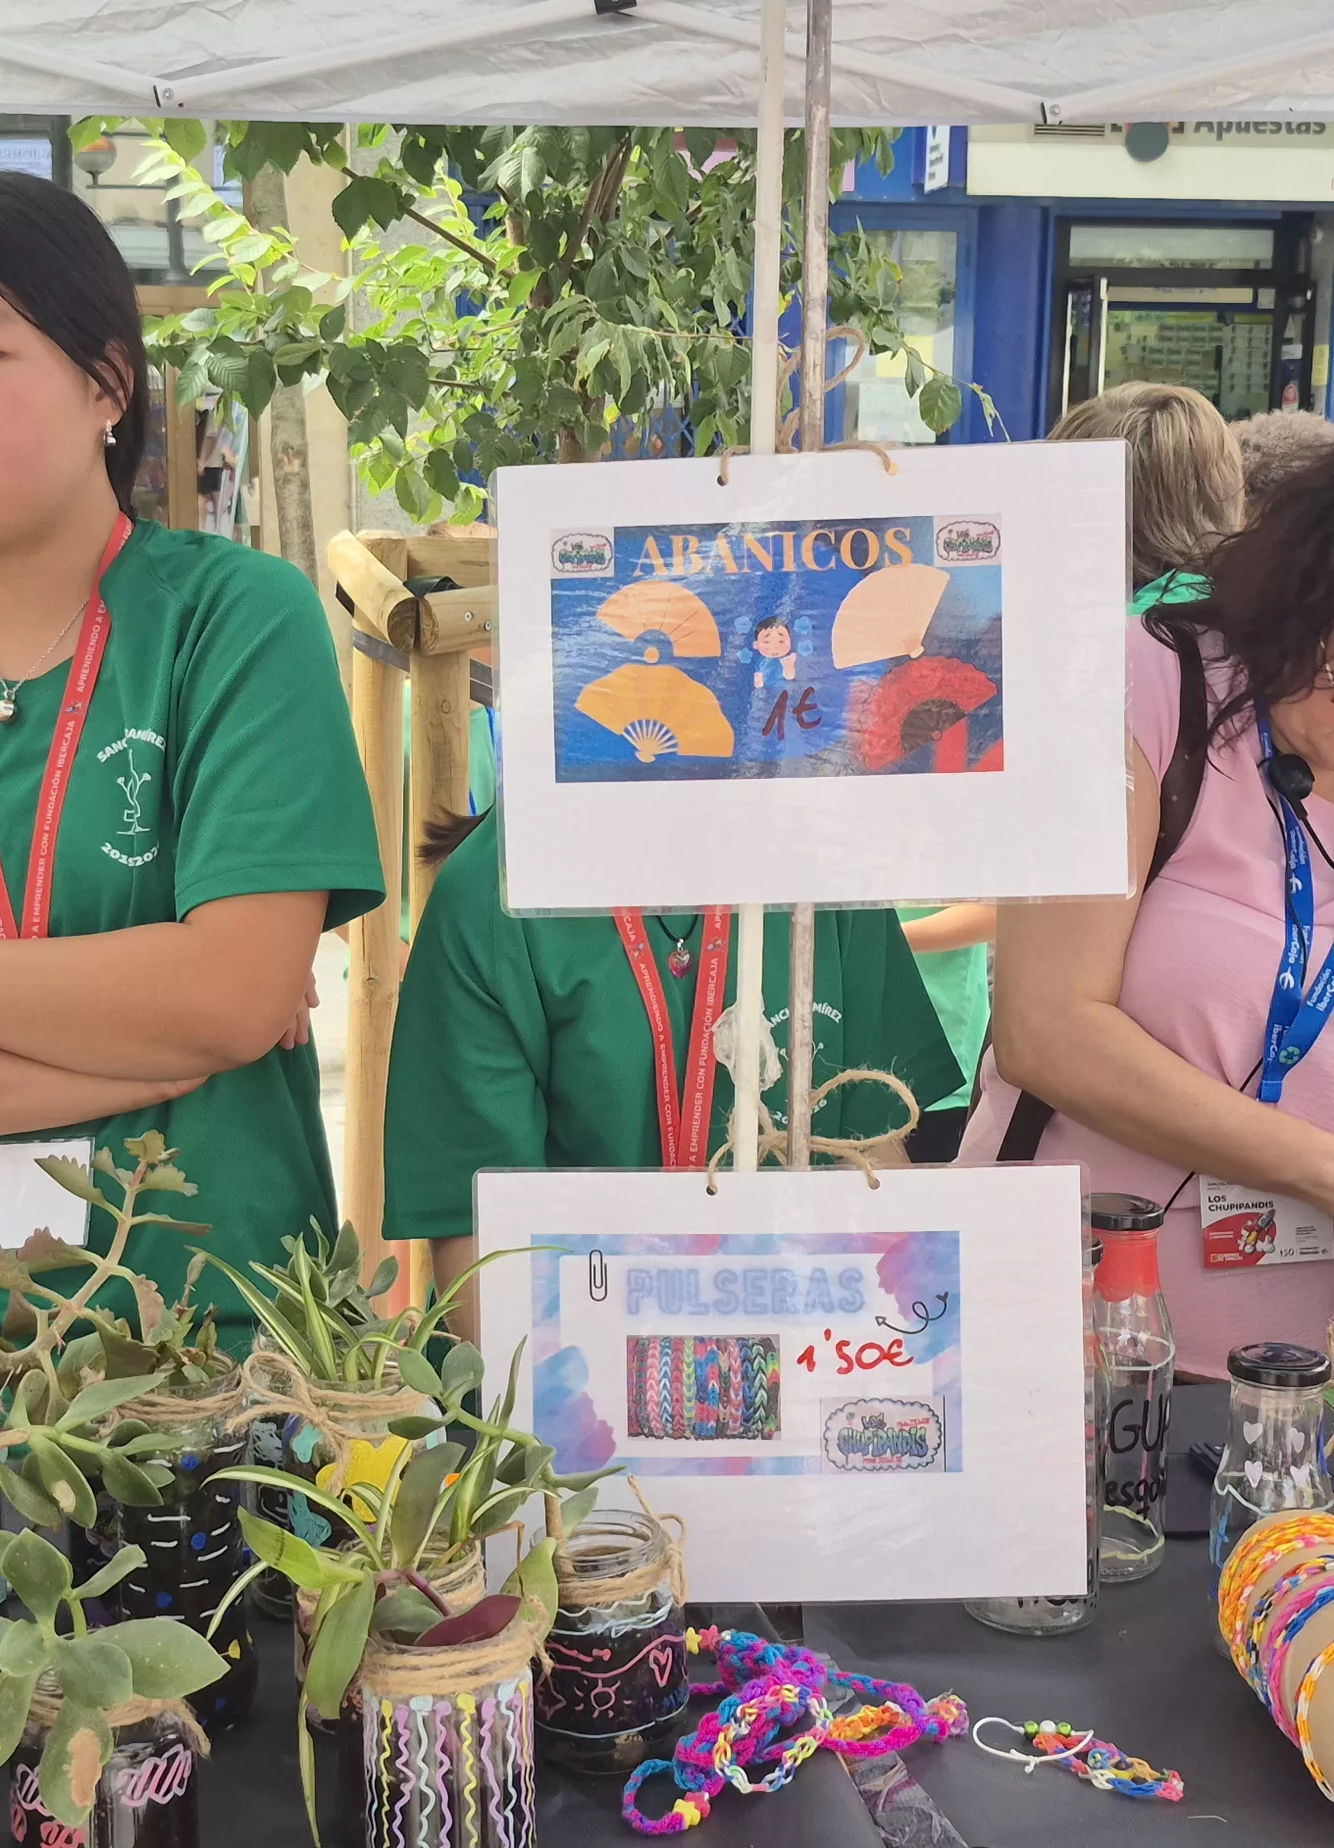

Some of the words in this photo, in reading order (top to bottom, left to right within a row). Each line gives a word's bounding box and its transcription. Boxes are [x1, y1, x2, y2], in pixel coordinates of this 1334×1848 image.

[632, 526, 914, 577] ABANICOS
[76, 623, 102, 694] APRENDIENDO
[762, 686, 823, 741] 1€
[33, 858, 46, 923] EMPRENDER
[40, 833, 50, 856] CON
[55, 719, 76, 769] IBERCAJA
[707, 957, 719, 1006] IBERCAJA
[696, 1068, 706, 1090] CON
[690, 1092, 704, 1152] EMPRENDER
[1207, 1194, 1227, 1204] LOS
[1208, 1200, 1274, 1212] CHUPIPANDIS
[625, 1266, 866, 1317] PULSERAS
